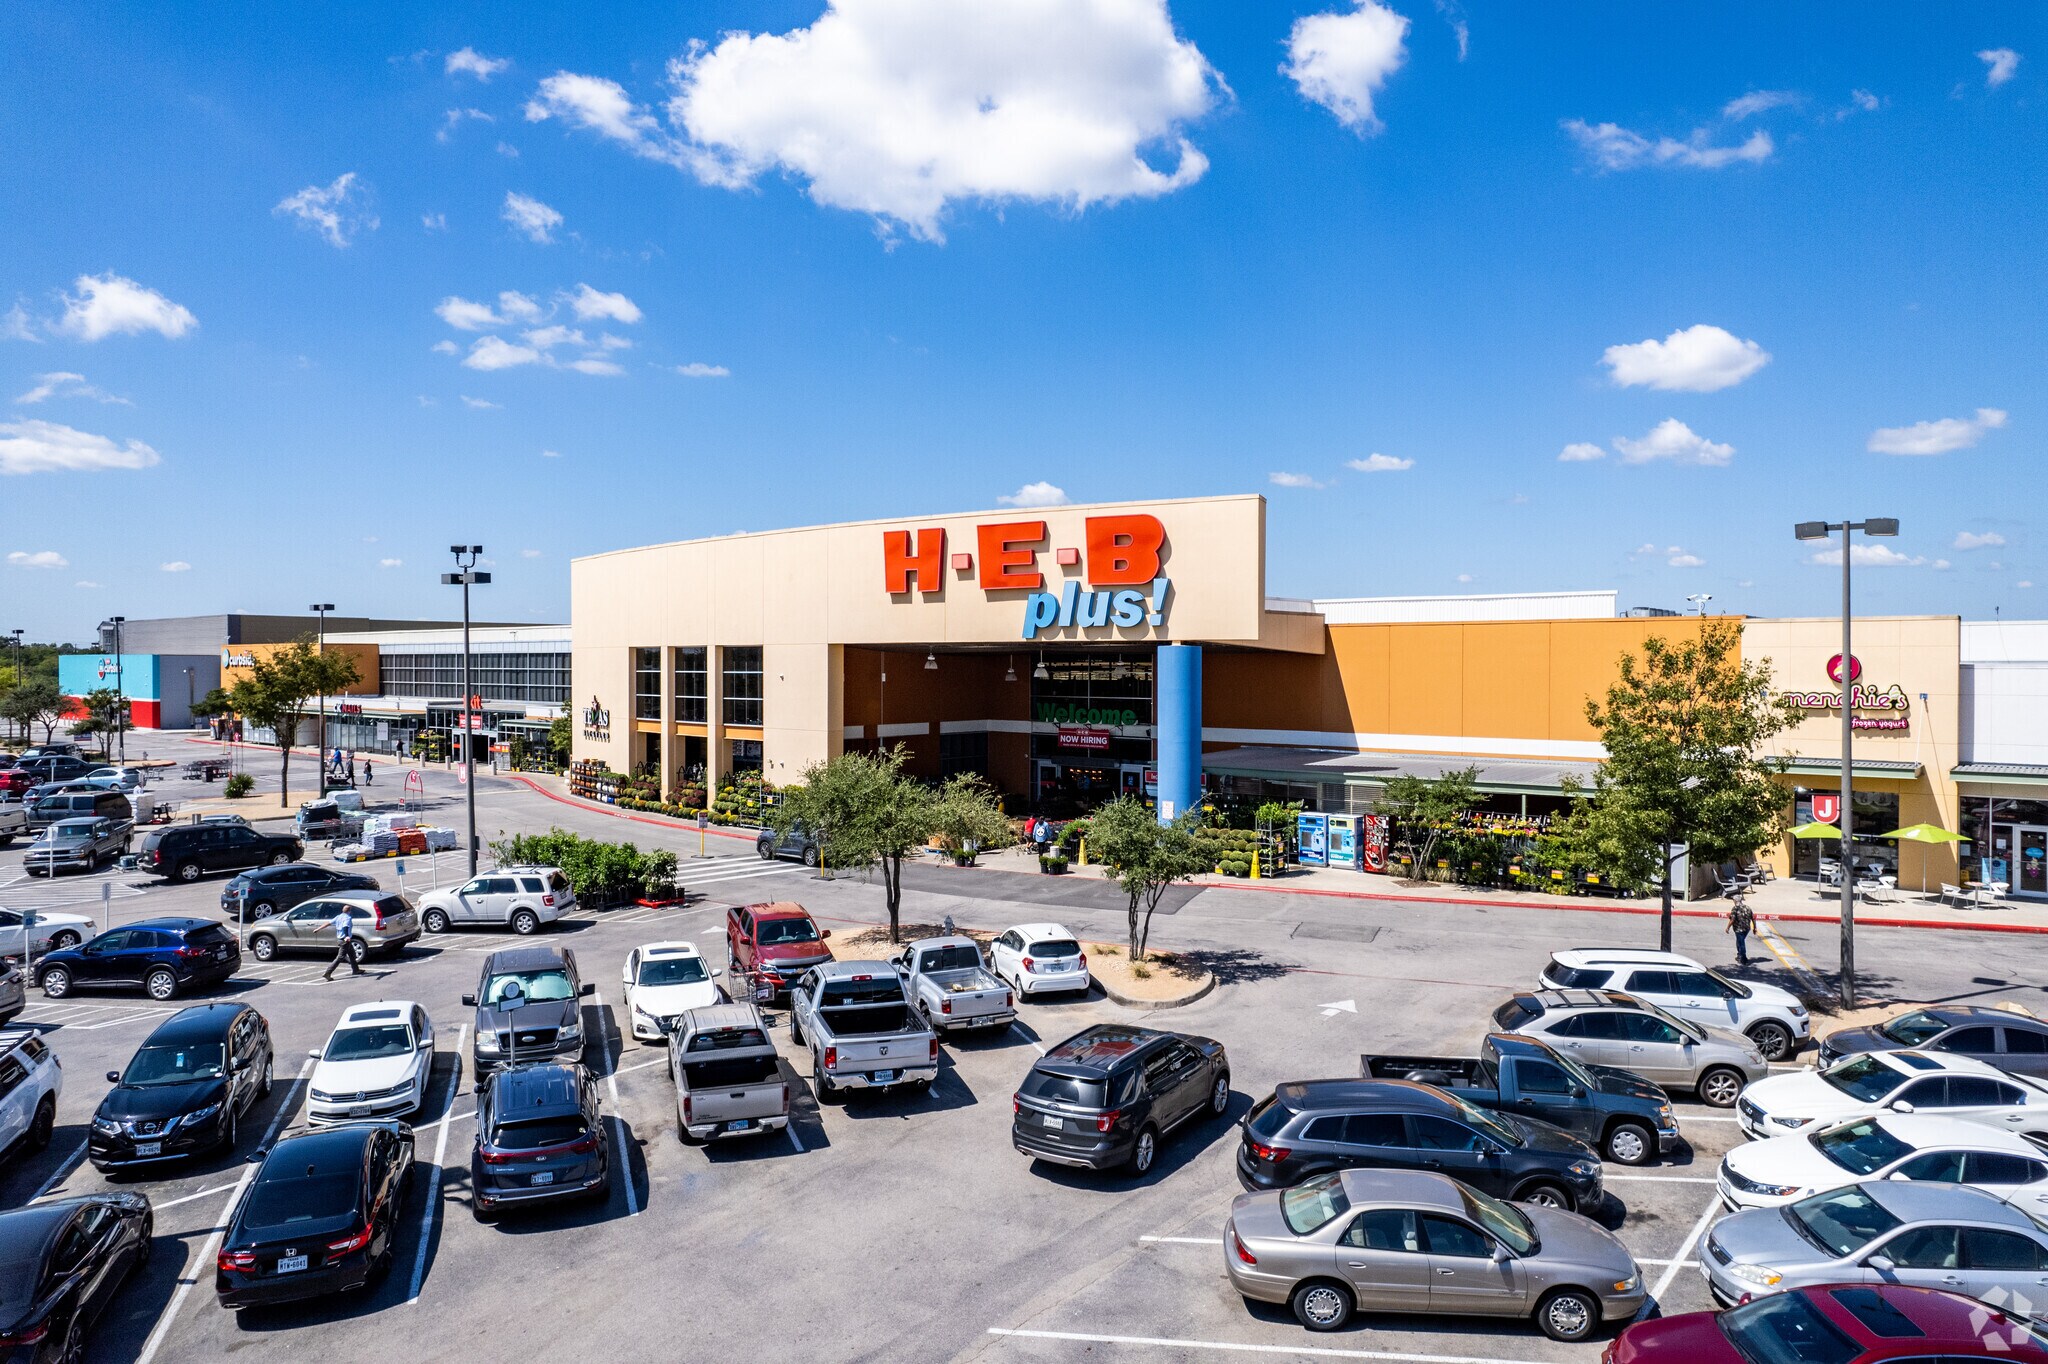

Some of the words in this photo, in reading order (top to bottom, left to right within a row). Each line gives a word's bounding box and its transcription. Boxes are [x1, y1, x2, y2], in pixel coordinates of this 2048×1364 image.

[1022, 578, 1171, 639] plus!
[342, 704, 362, 714] NAILS
[1037, 702, 1136, 726] Welcome
[1851, 718, 1877, 729] frozen
[1879, 719, 1907, 730] yogurt
[1060, 735, 1080, 743] NOW
[1080, 736, 1108, 745] HIRING
[460, 766, 467, 778] H
[1818, 799, 1832, 818] J
